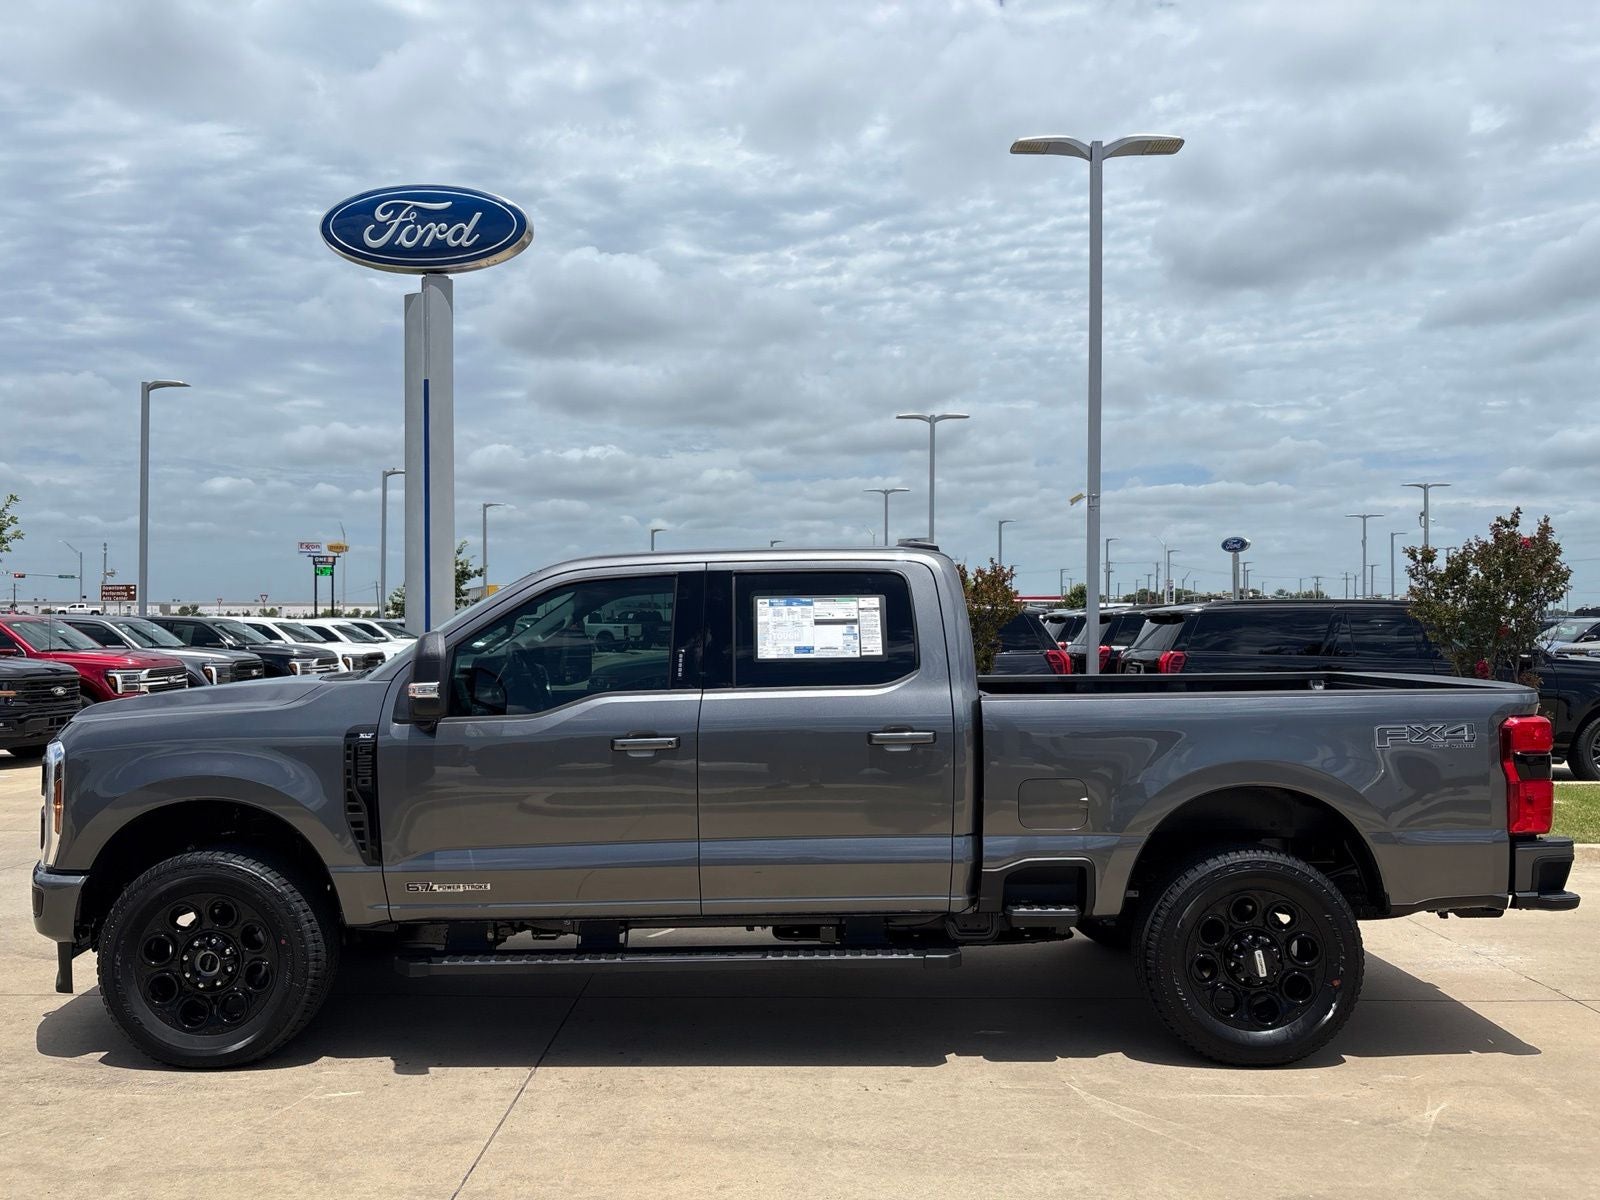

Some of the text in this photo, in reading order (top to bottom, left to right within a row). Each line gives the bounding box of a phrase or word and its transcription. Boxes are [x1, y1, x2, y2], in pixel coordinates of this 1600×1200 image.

[363, 200, 483, 249] Ford
[300, 542, 320, 551] Exxon
[1375, 723, 1476, 749] FX4
